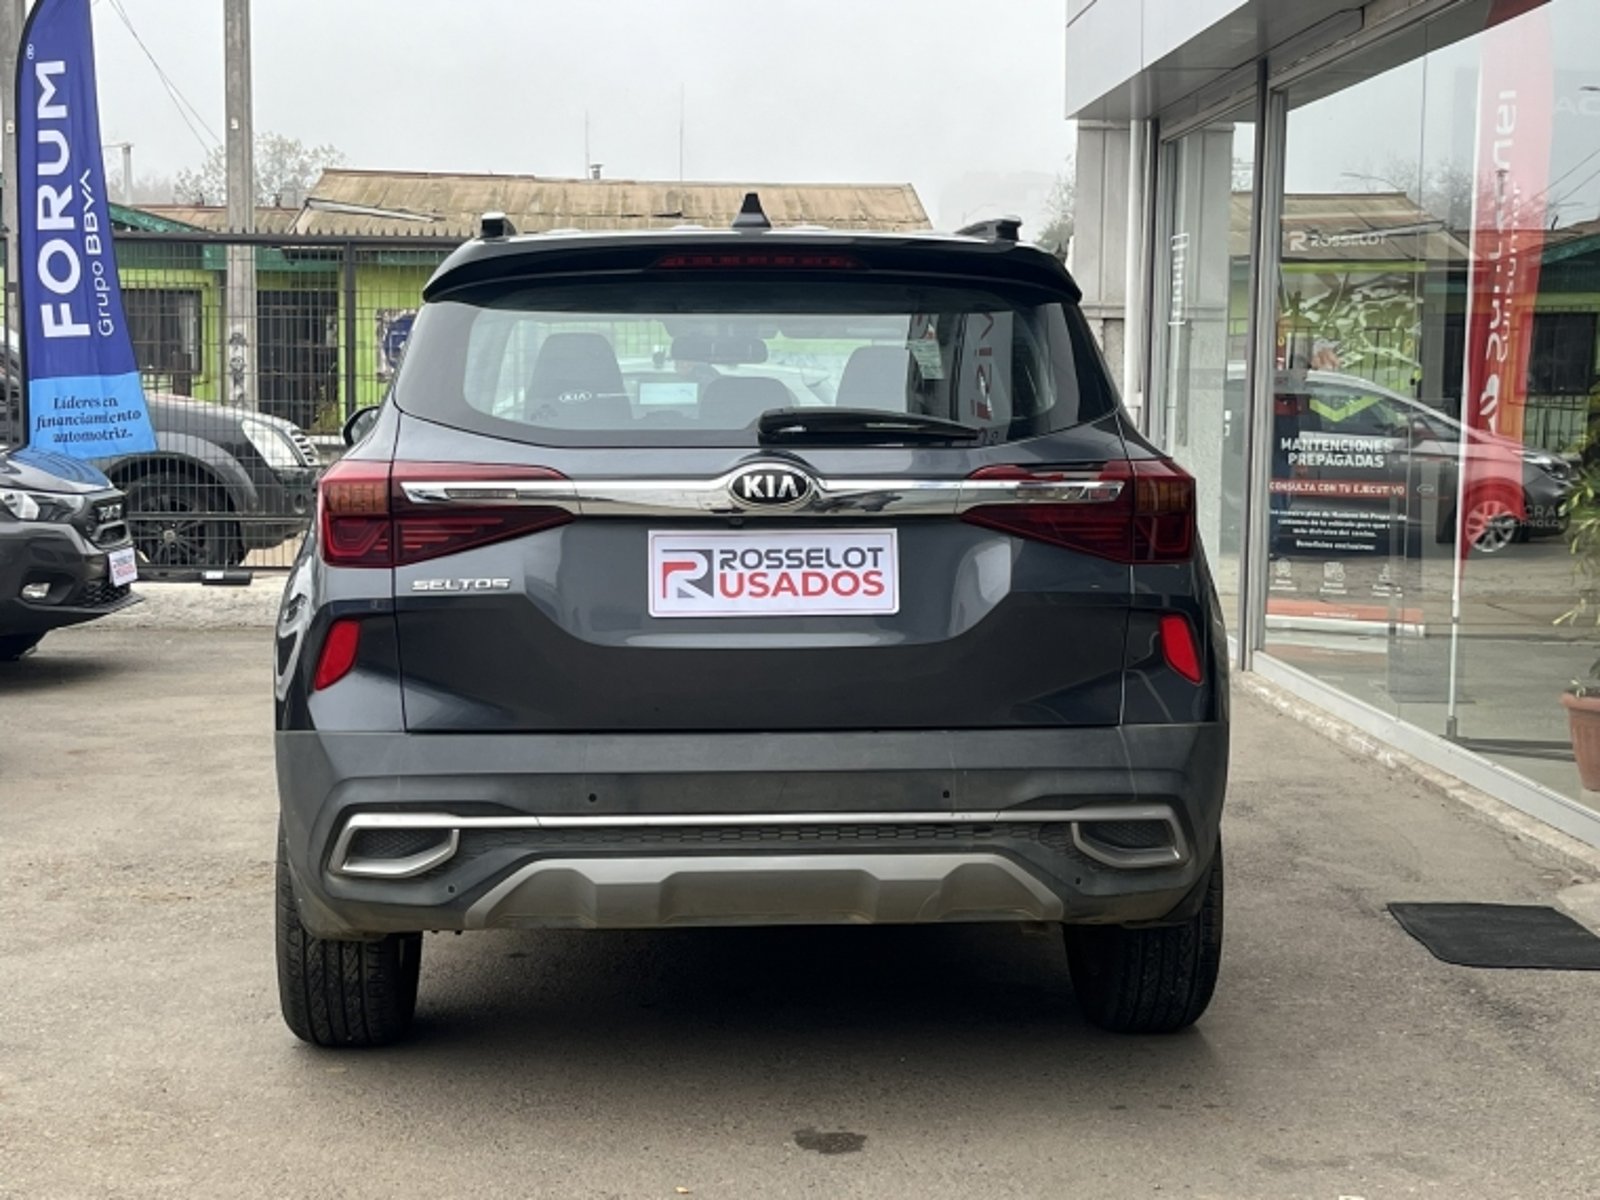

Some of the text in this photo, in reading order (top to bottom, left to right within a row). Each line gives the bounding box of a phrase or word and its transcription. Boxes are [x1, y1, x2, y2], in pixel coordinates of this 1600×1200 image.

[36, 61, 91, 338] FORUM
[80, 168, 115, 337] Grupo BBVA
[36, 410, 142, 432] financiamiento
[1281, 437, 1394, 453] MANTENCIONES
[1288, 452, 1385, 468] PREPAGADAS
[743, 475, 799, 498] KIA
[1353, 484, 1405, 496] EJECUTVO
[719, 547, 885, 570] ROSSELOT
[412, 578, 511, 592] SELTOS
[719, 571, 885, 599] USADOS
